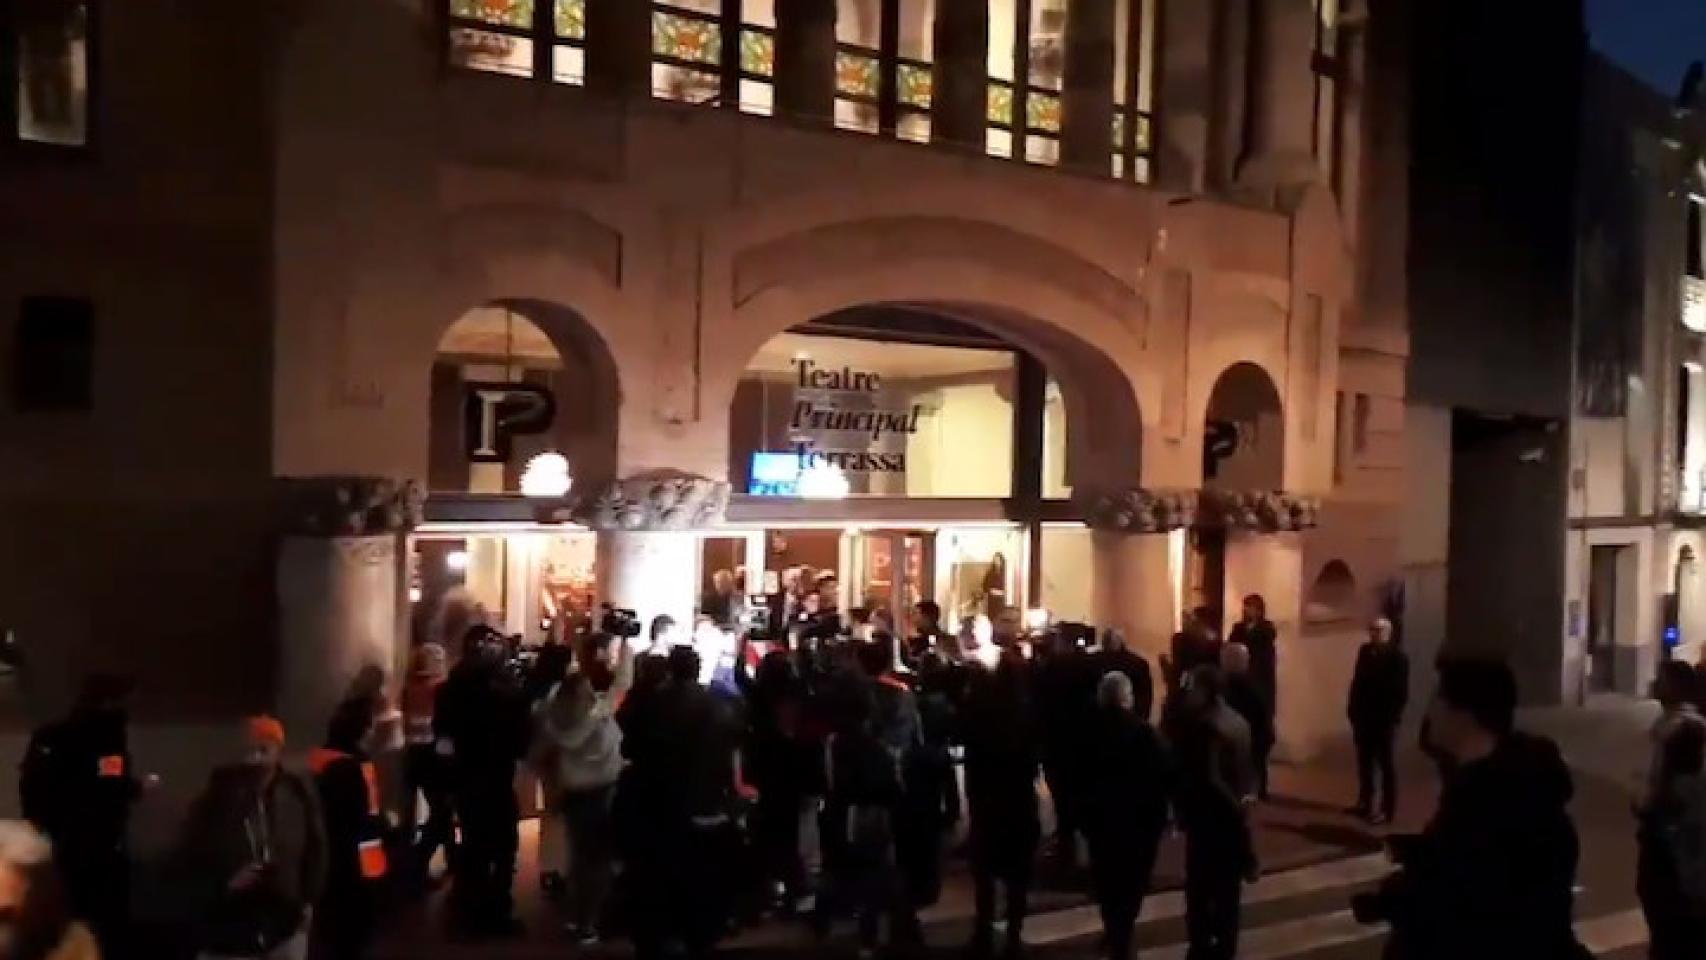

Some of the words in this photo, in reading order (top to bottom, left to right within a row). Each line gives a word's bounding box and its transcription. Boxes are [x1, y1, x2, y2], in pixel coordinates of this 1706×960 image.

[790, 357, 880, 391] Teatre
[464, 382, 556, 463] P
[791, 400, 920, 441] Principal
